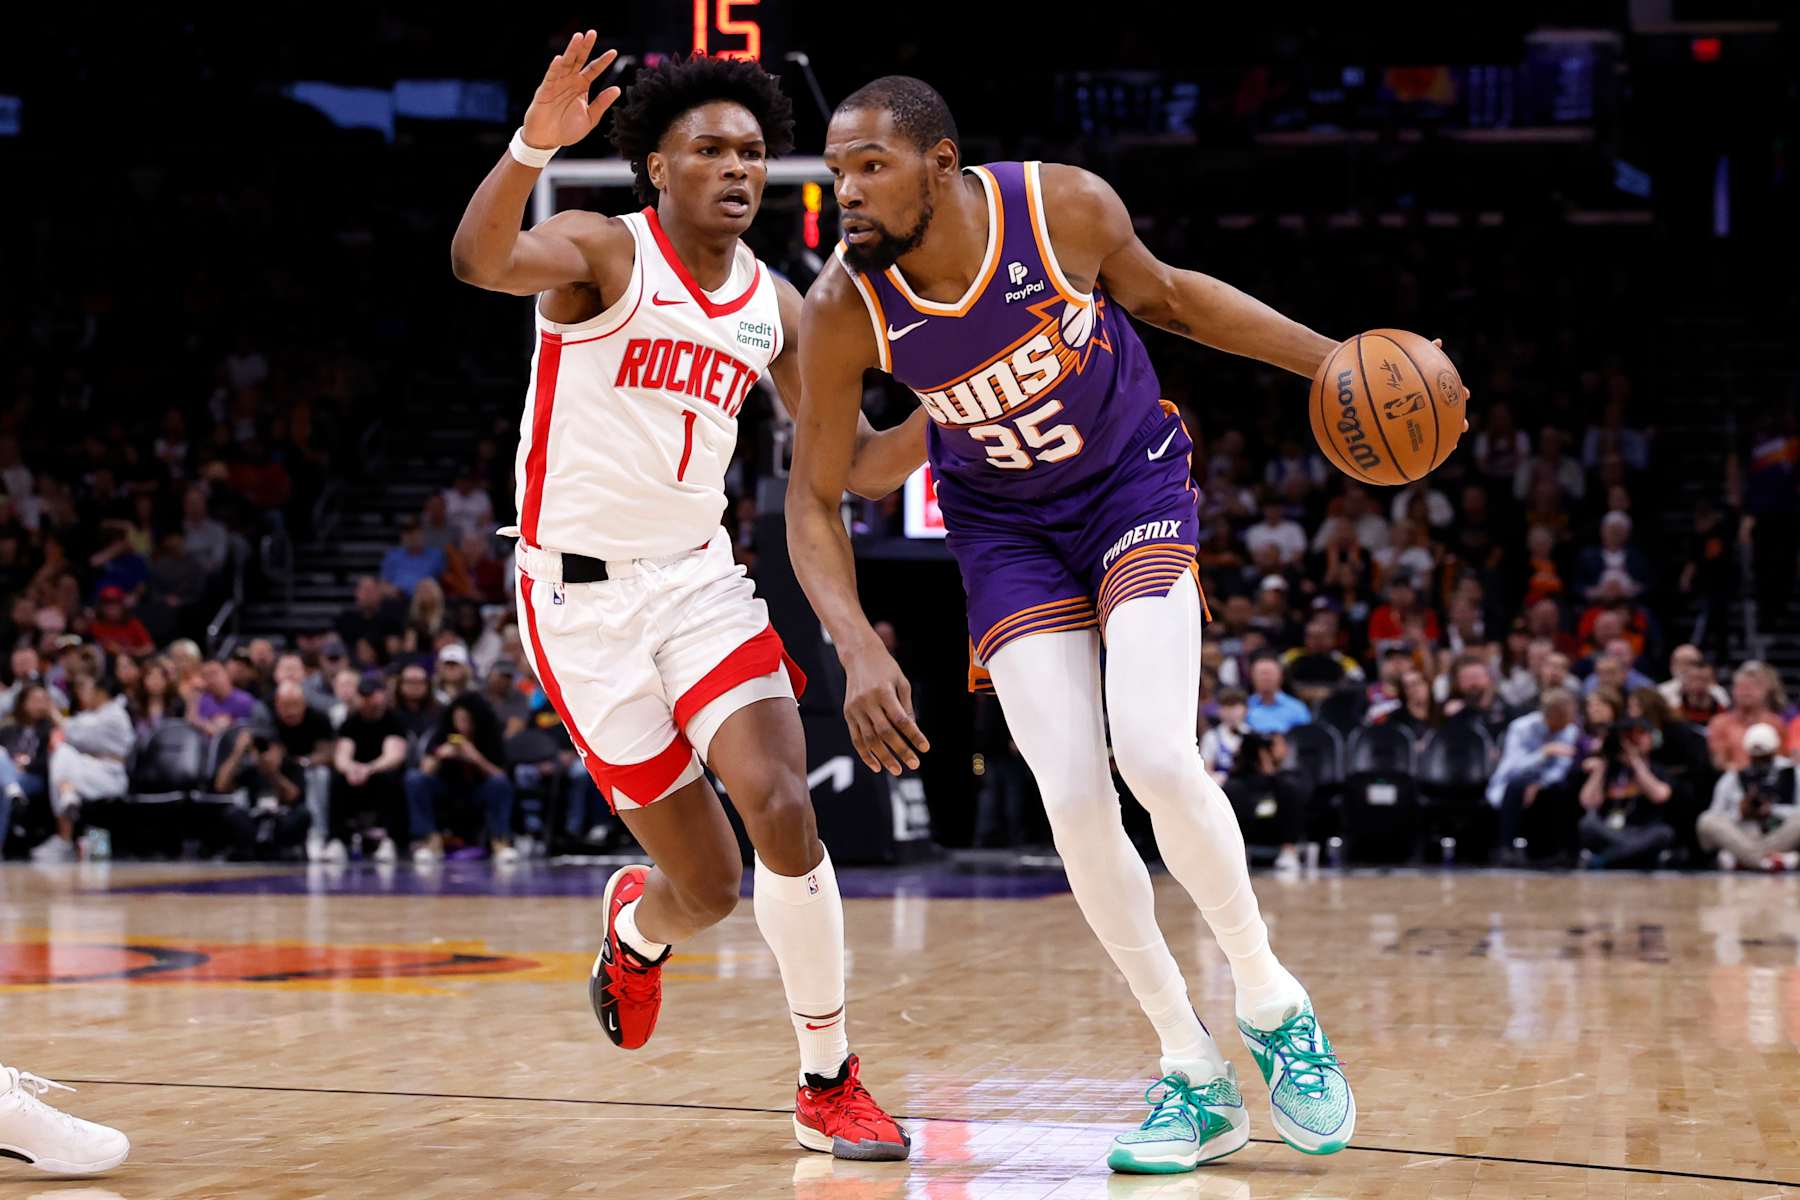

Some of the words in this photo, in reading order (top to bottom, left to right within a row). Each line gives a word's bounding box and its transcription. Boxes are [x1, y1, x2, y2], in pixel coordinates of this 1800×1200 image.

[693, 0, 760, 62] 15
[1005, 279, 1045, 304] PayPal
[736, 329, 770, 350] karma
[739, 320, 772, 337] credit
[614, 337, 760, 418] ROCKETS
[677, 409, 697, 482] 1
[967, 399, 1085, 470] 35
[1336, 368, 1381, 471] Wilson
[1103, 520, 1182, 571] PHOENIX
